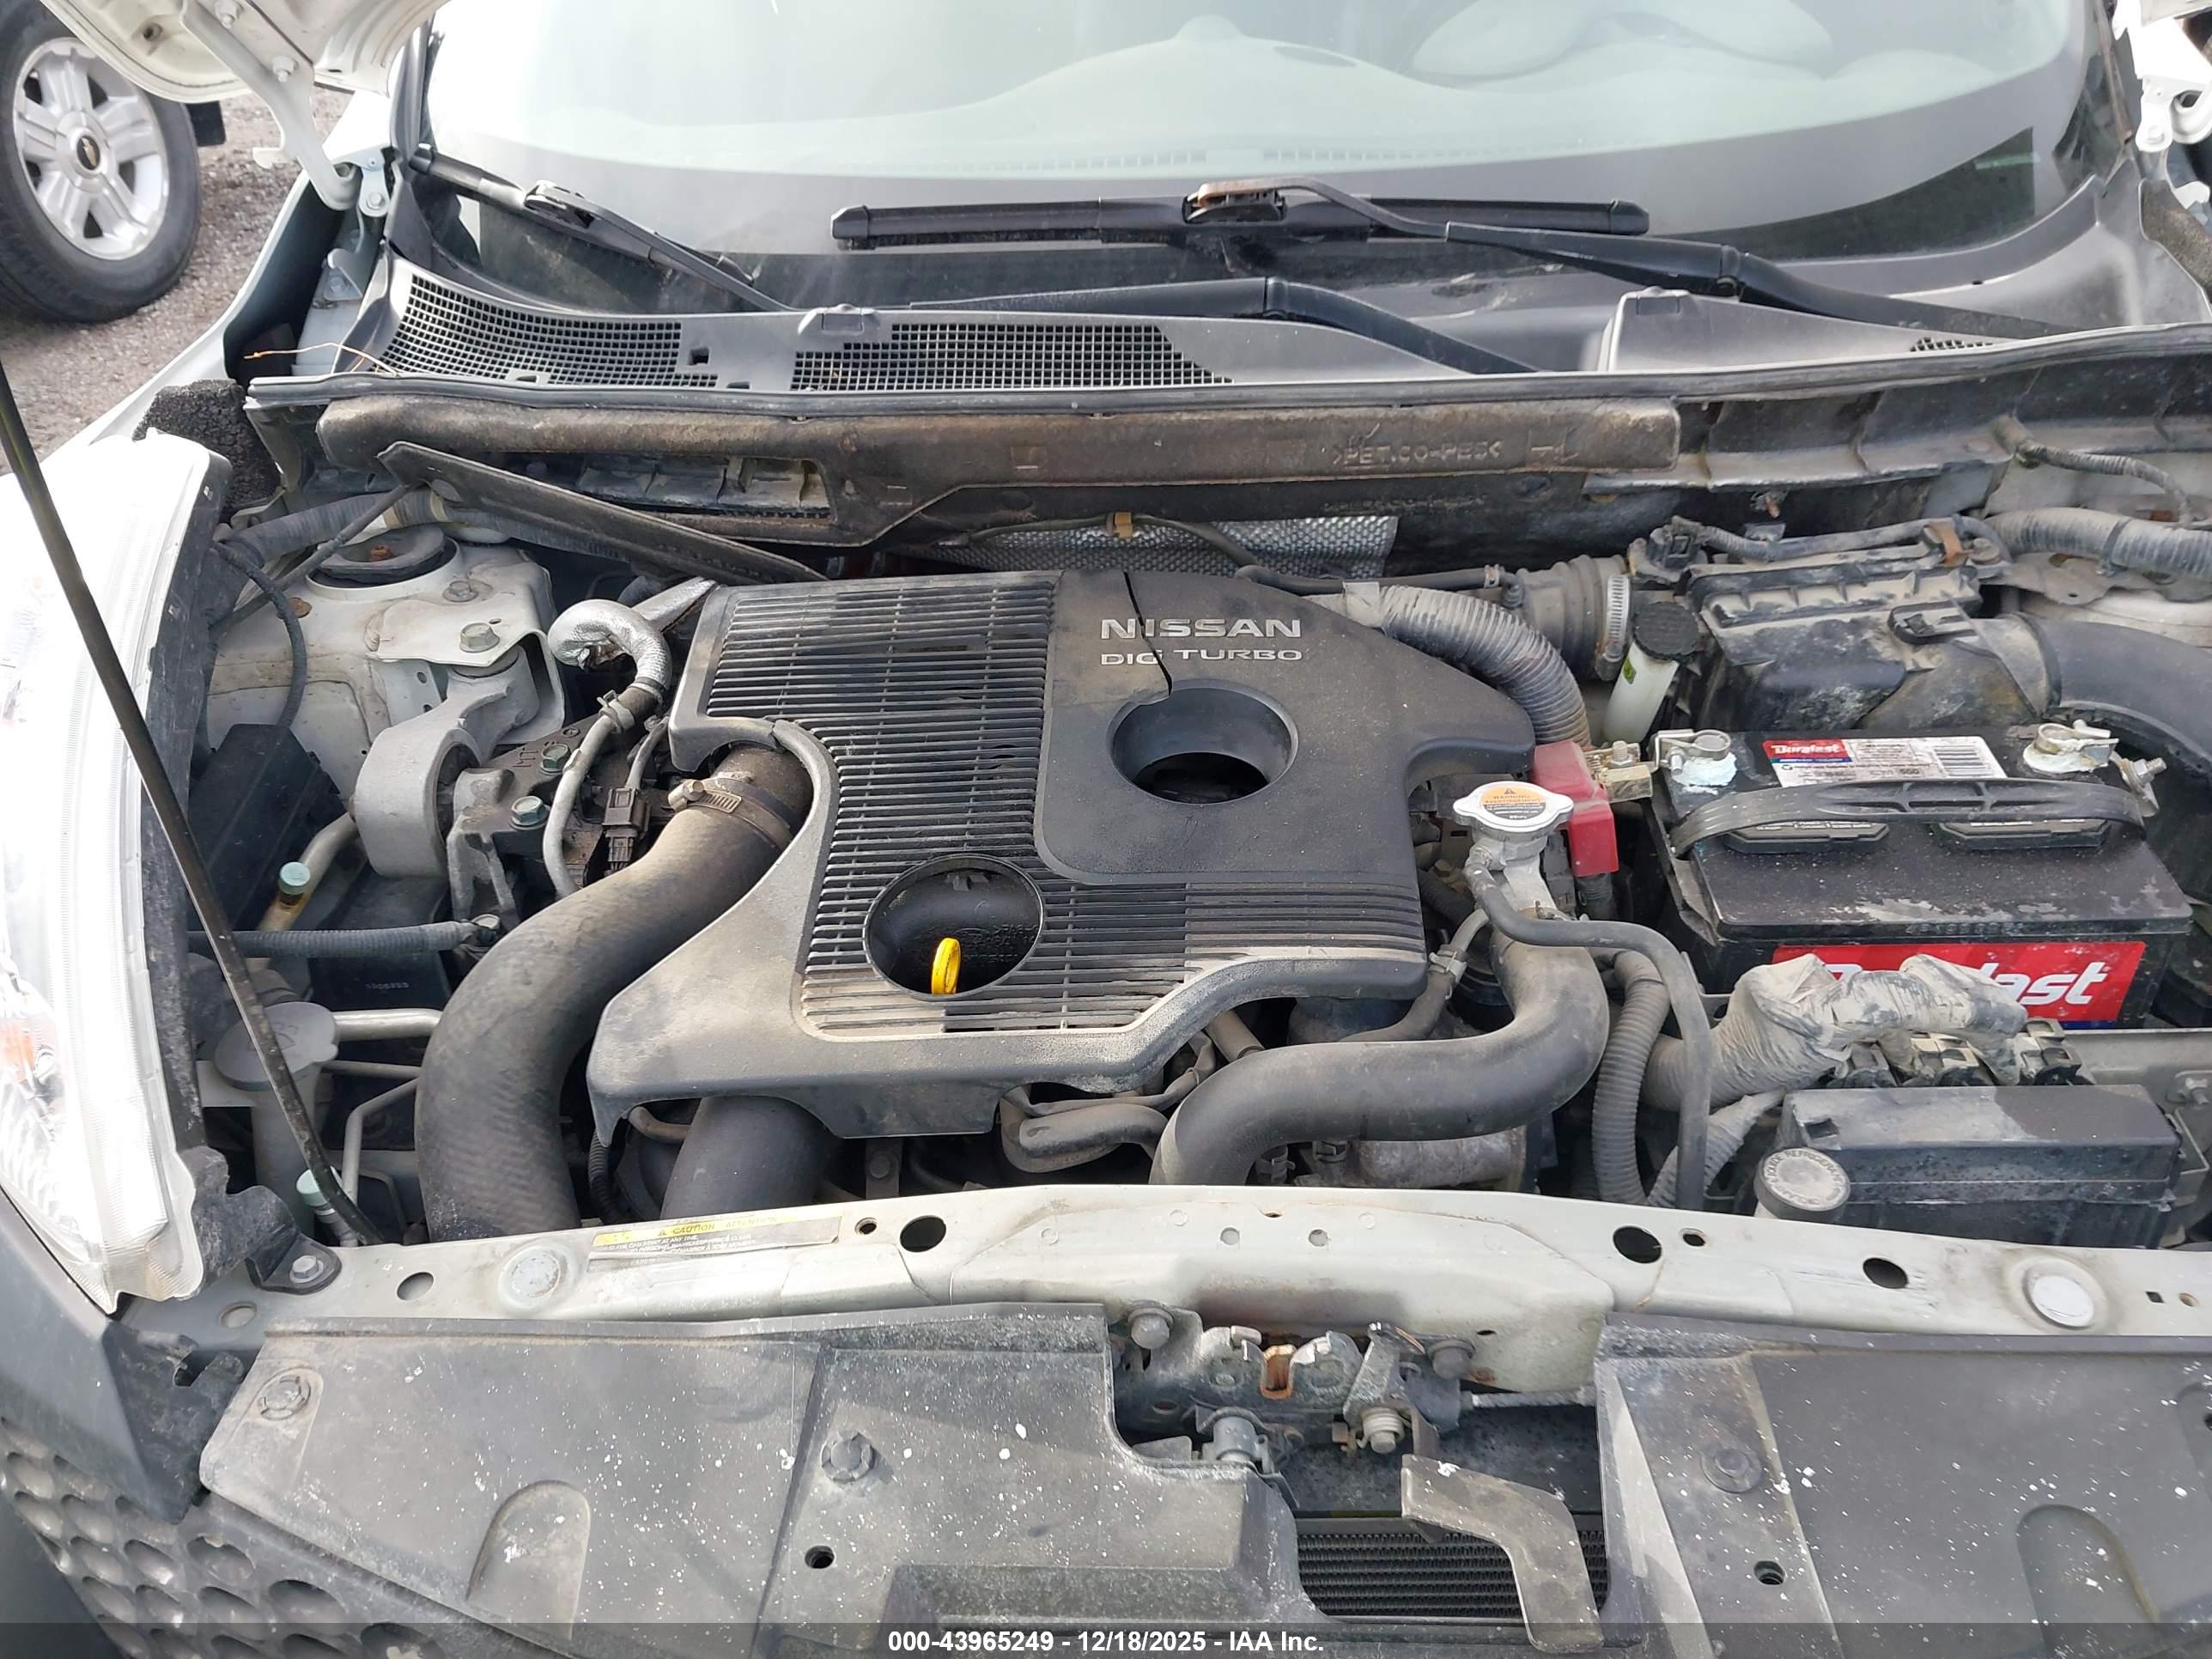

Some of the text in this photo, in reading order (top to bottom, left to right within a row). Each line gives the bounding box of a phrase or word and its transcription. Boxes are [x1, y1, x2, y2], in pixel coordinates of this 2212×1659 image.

[1101, 617, 1302, 640] NISSAN
[1101, 648, 1303, 665] DIG TURBO
[672, 1223, 715, 1235] CAUTION
